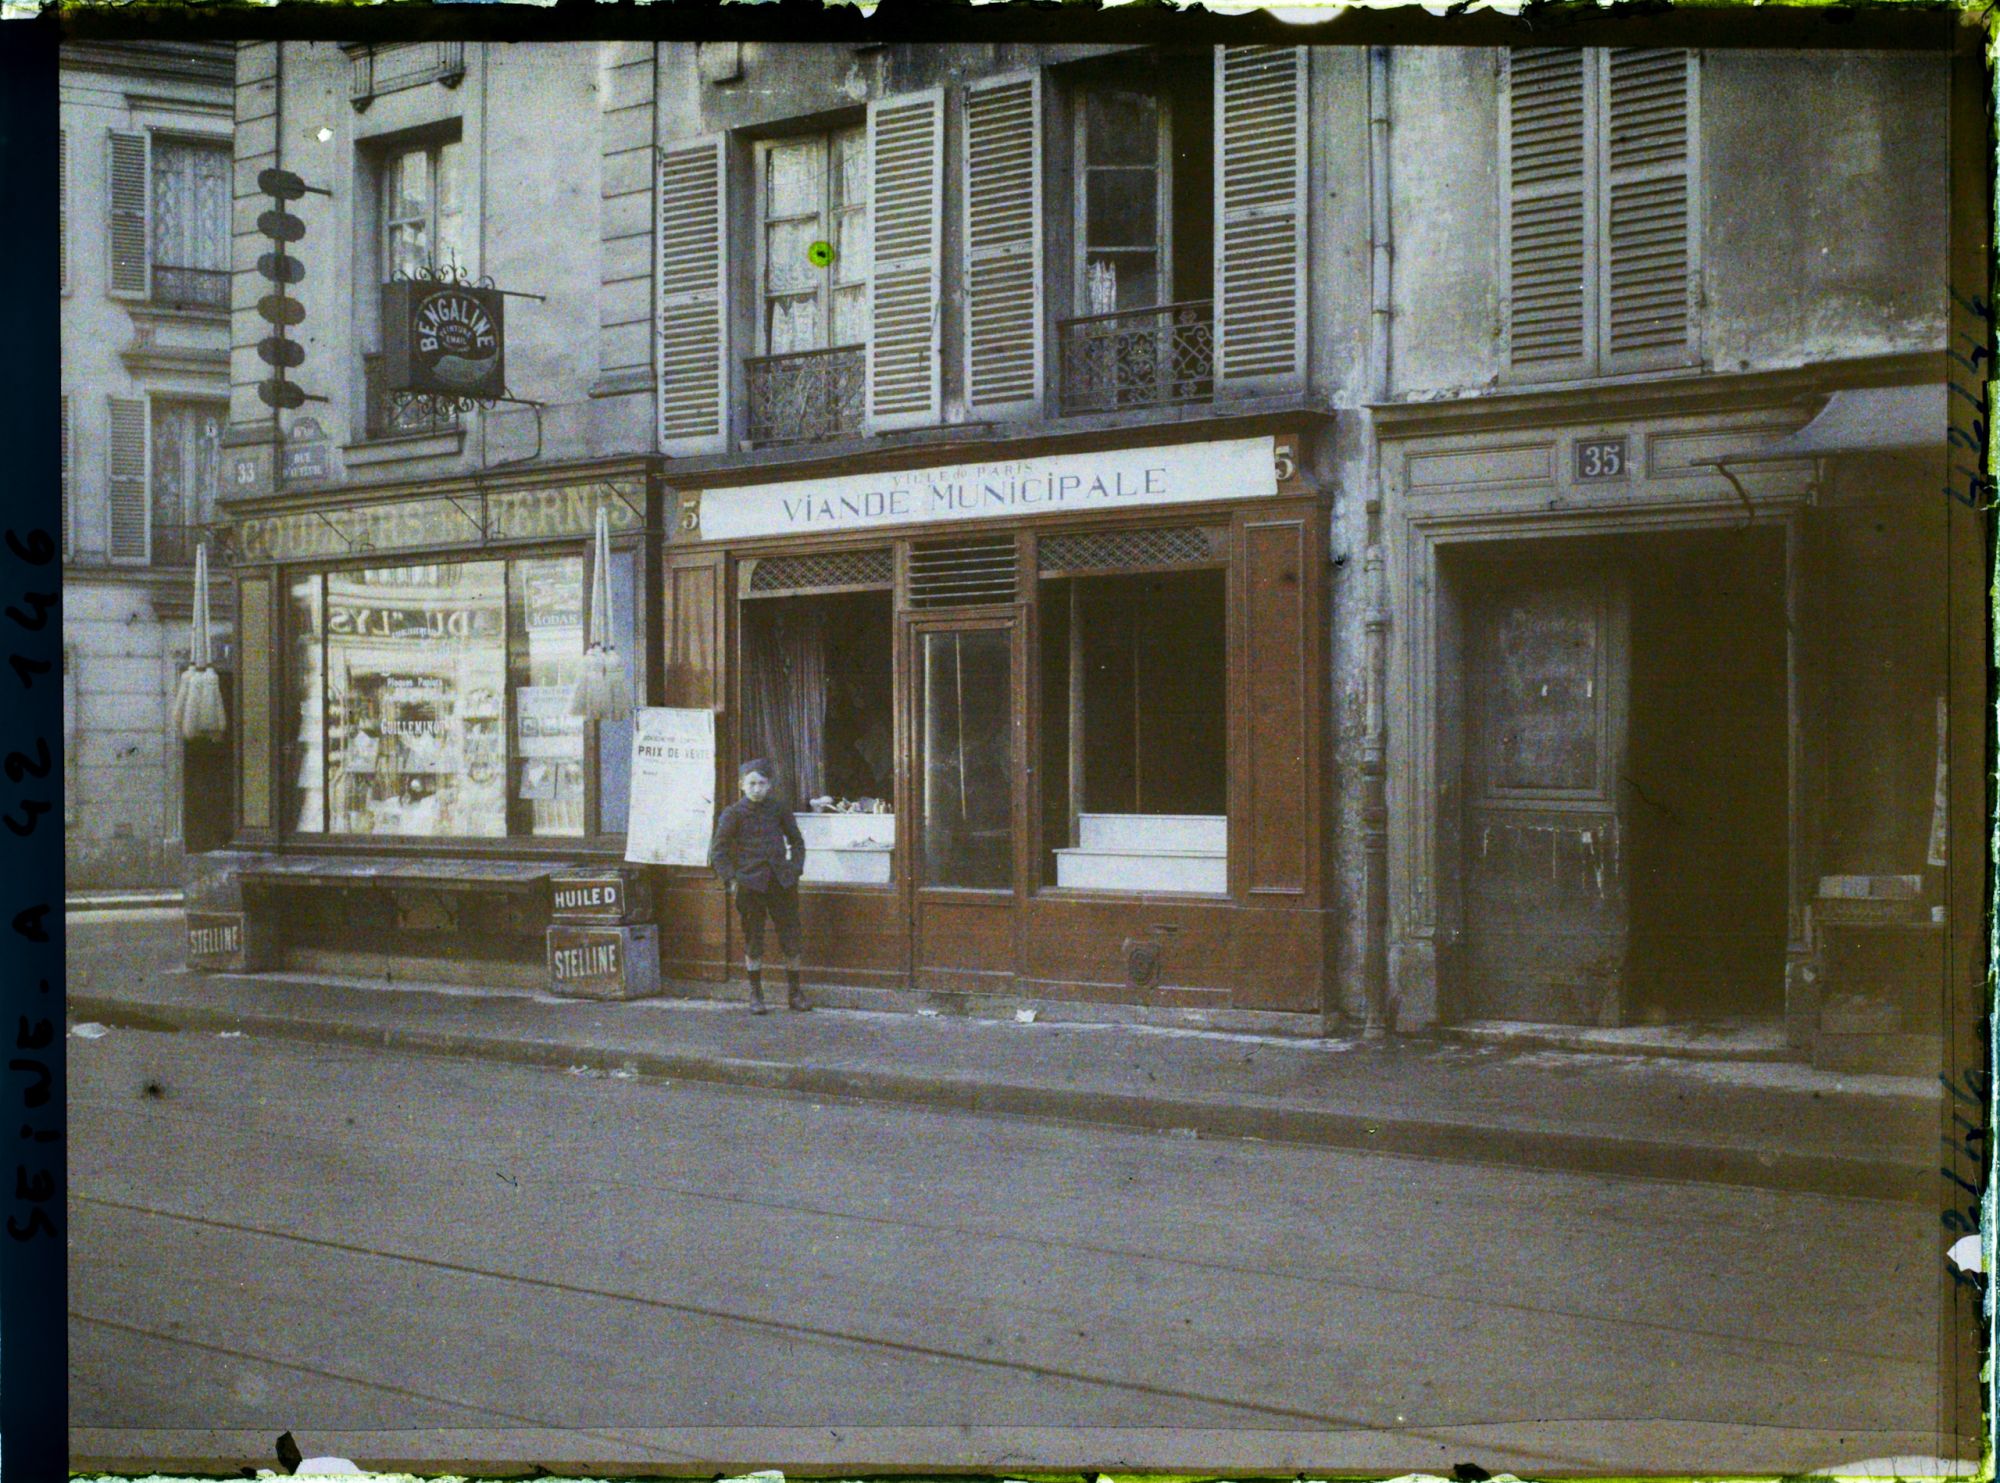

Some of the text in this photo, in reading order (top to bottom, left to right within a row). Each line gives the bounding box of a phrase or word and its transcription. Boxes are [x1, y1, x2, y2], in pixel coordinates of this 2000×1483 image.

[419, 297, 496, 352] BENGALINE
[238, 462, 254, 483] 33
[977, 460, 1032, 479] PARIS
[1275, 445, 1294, 480] 5
[1585, 444, 1621, 476] 35
[783, 467, 1167, 522] VIANDE MUNICIPALE
[532, 611, 578, 626] KODAK
[637, 745, 663, 757] PRIX
[667, 746, 680, 759] DE
[12, 903, 50, 942] A
[191, 926, 239, 954] STELLINE
[554, 944, 617, 979] STELLINE
